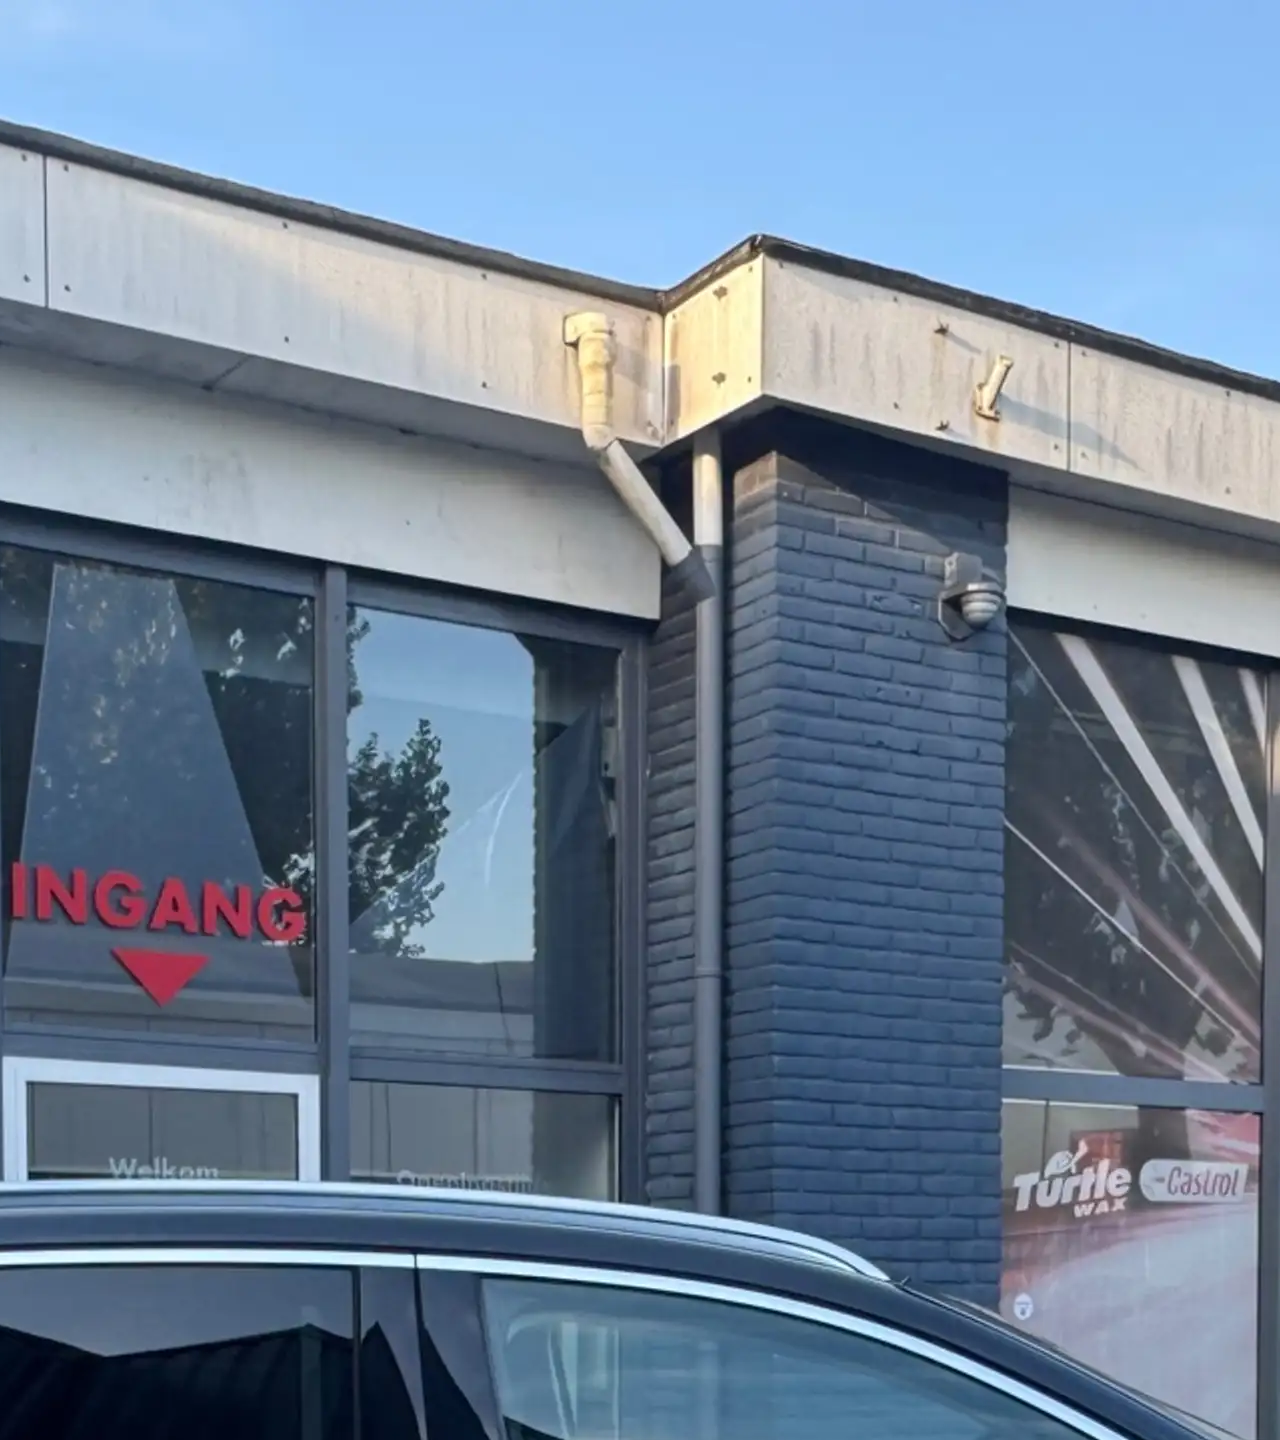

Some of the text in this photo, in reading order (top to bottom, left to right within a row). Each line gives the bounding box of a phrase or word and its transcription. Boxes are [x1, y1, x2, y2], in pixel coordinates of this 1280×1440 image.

[10, 860, 308, 942] INGANG
[1013, 1158, 1132, 1212] Turtle
[1166, 1166, 1240, 1197] Castrol
[1074, 1197, 1128, 1218] WAX
